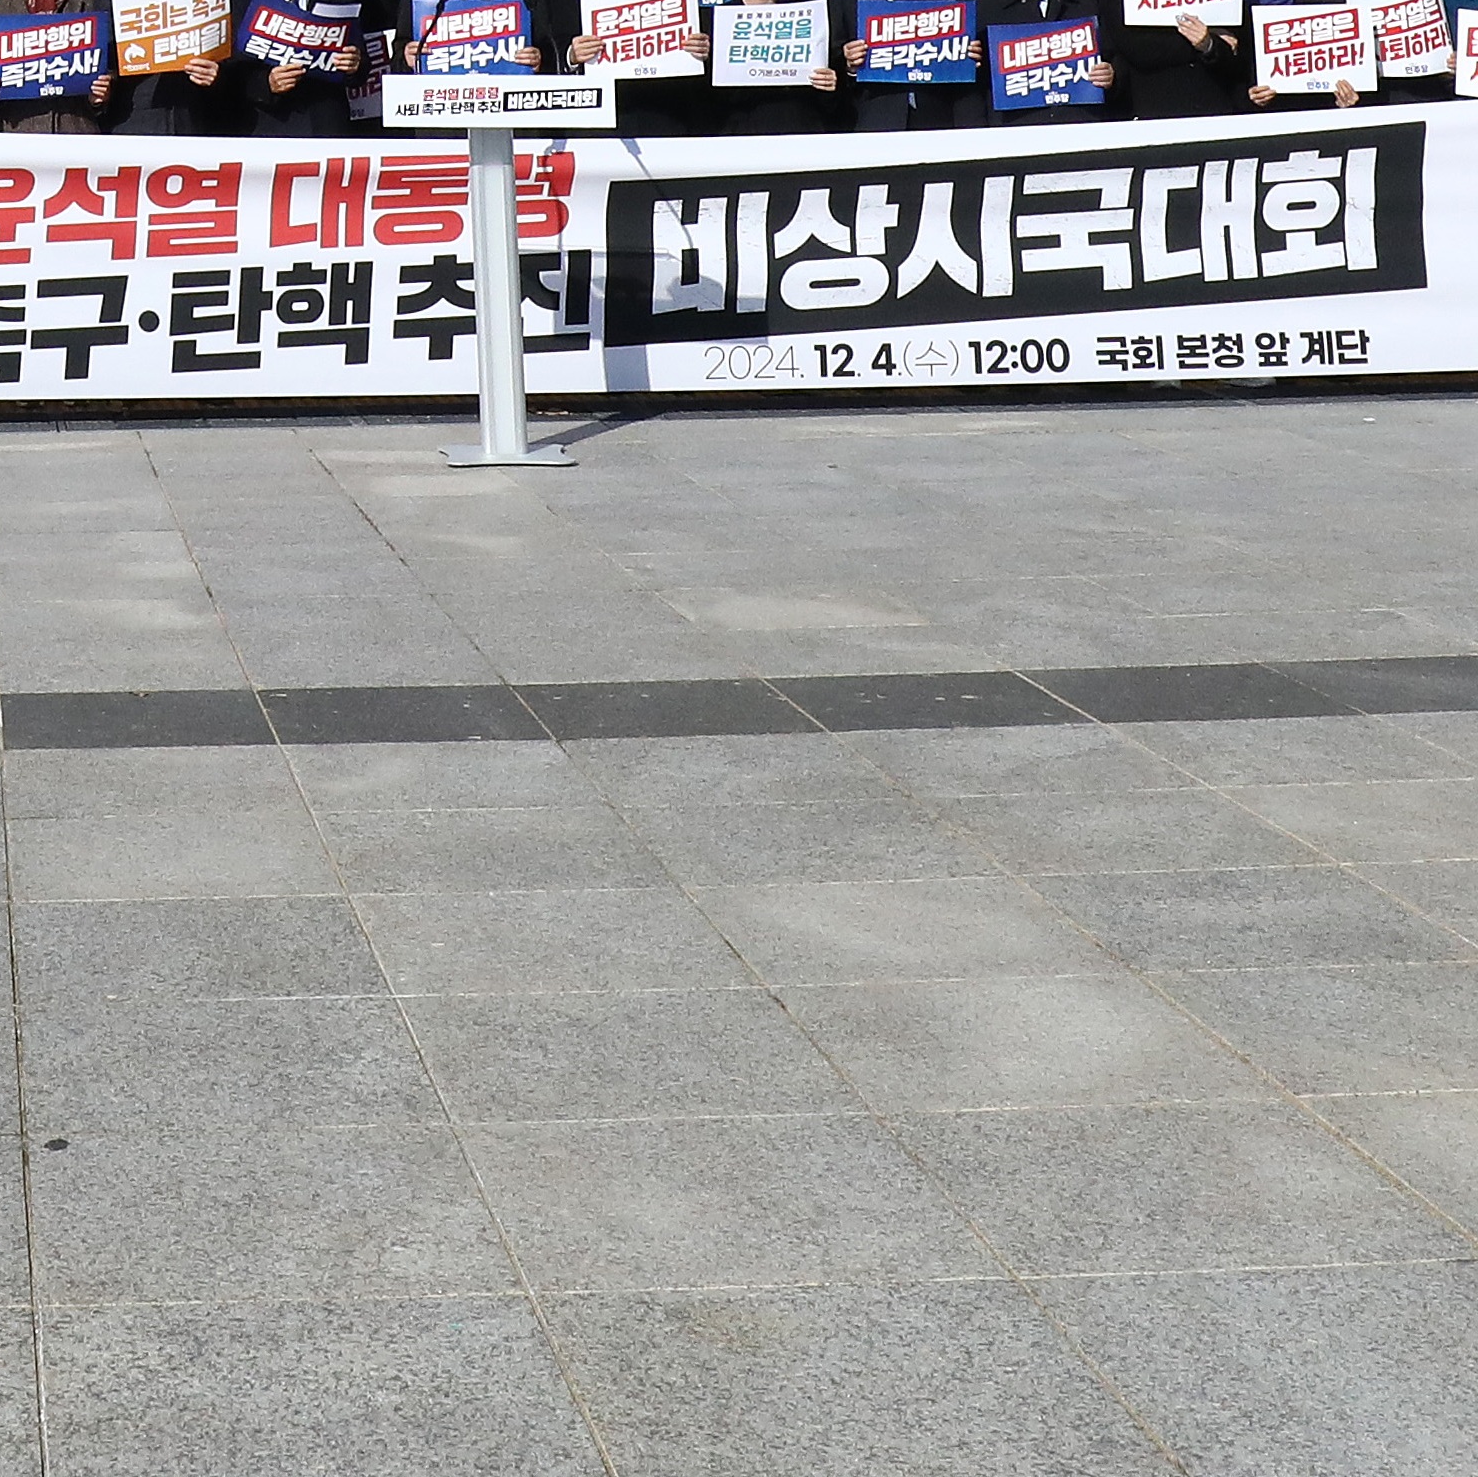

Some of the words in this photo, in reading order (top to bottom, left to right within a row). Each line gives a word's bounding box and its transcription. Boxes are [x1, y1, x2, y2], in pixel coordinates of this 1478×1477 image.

[120, 1, 187, 34] 국회는
[254, 11, 347, 47] 내란행위
[426, 6, 515, 42] 내란행위
[594, 0, 686, 36] 윤석열은
[733, 19, 812, 39] 윤석열을
[870, 6, 963, 42] 내란행위
[1267, 11, 1359, 49] 윤석열은
[0, 25, 93, 59] 내란행위
[154, 20, 226, 64] 탄핵을!
[729, 44, 811, 63] 탄핵하라
[869, 35, 969, 72] 즉각수사!
[1001, 24, 1095, 71] 내란행위
[0, 51, 101, 89] 즉각수사!
[908, 70, 932, 81] 민주당
[1269, 42, 1365, 79] 사퇴하라!
[396, 103, 419, 116] 사퇴
[422, 102, 474, 115] 촉구·탄핵
[477, 101, 501, 112] 추진
[424, 88, 459, 101] 윤석열
[462, 87, 499, 99] 대통령
[508, 91, 597, 109] 비상시국대회
[270, 155, 575, 249] 대통령
[651, 144, 1378, 314] 비상시국대회
[393, 248, 592, 361] 추진
[704, 344, 806, 383] 2024.
[813, 343, 859, 381] 12.
[870, 338, 959, 378] 4.(수)
[968, 336, 1071, 375] 12:00
[1095, 334, 1164, 372] 국회
[1175, 332, 1245, 370] 본청
[1255, 331, 1291, 367] 앞
[1300, 328, 1369, 365] 계단
